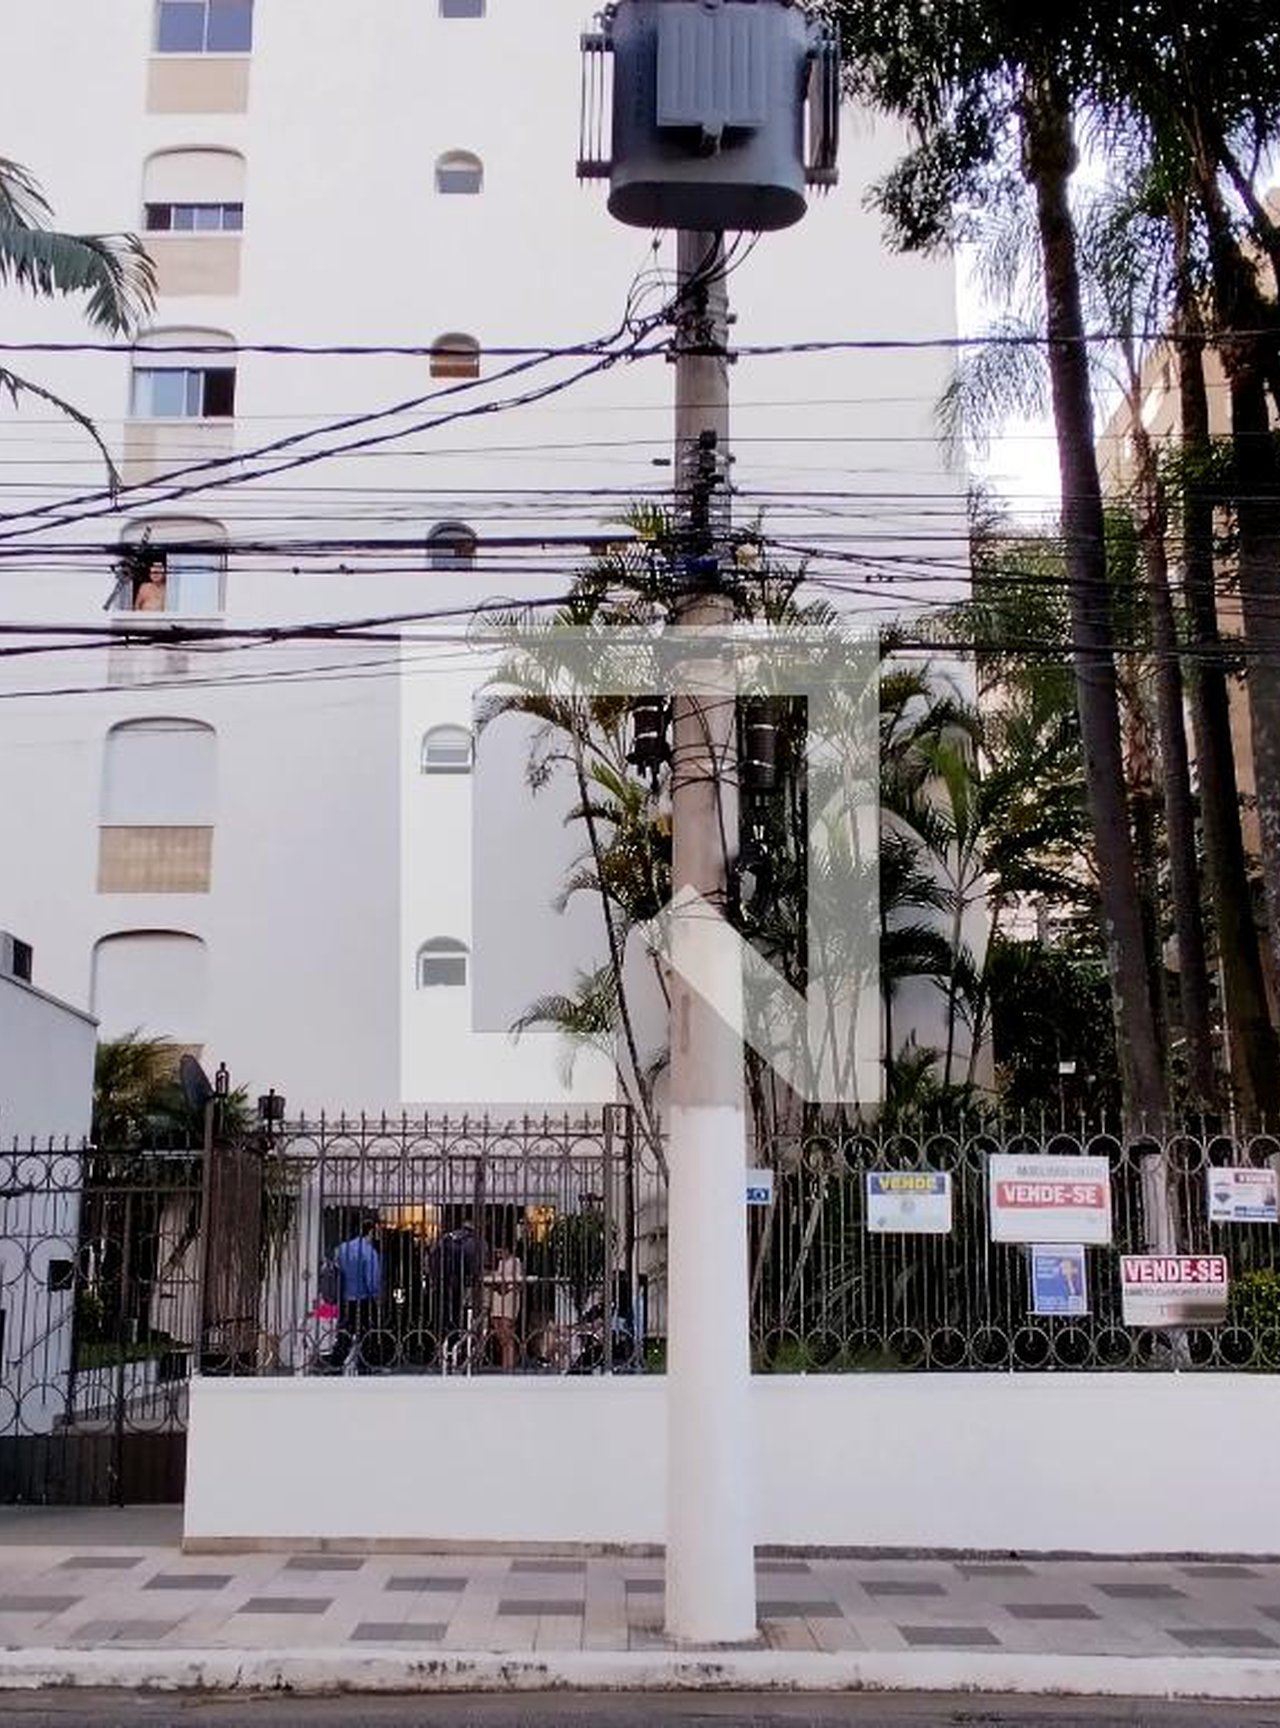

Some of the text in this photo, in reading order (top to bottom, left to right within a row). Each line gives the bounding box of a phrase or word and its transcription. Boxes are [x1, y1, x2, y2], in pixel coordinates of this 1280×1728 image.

[880, 1175, 934, 1191] VENDE
[1002, 1183, 1098, 1204] VENDE-SE
[1126, 1260, 1223, 1281] VENDE-SE
